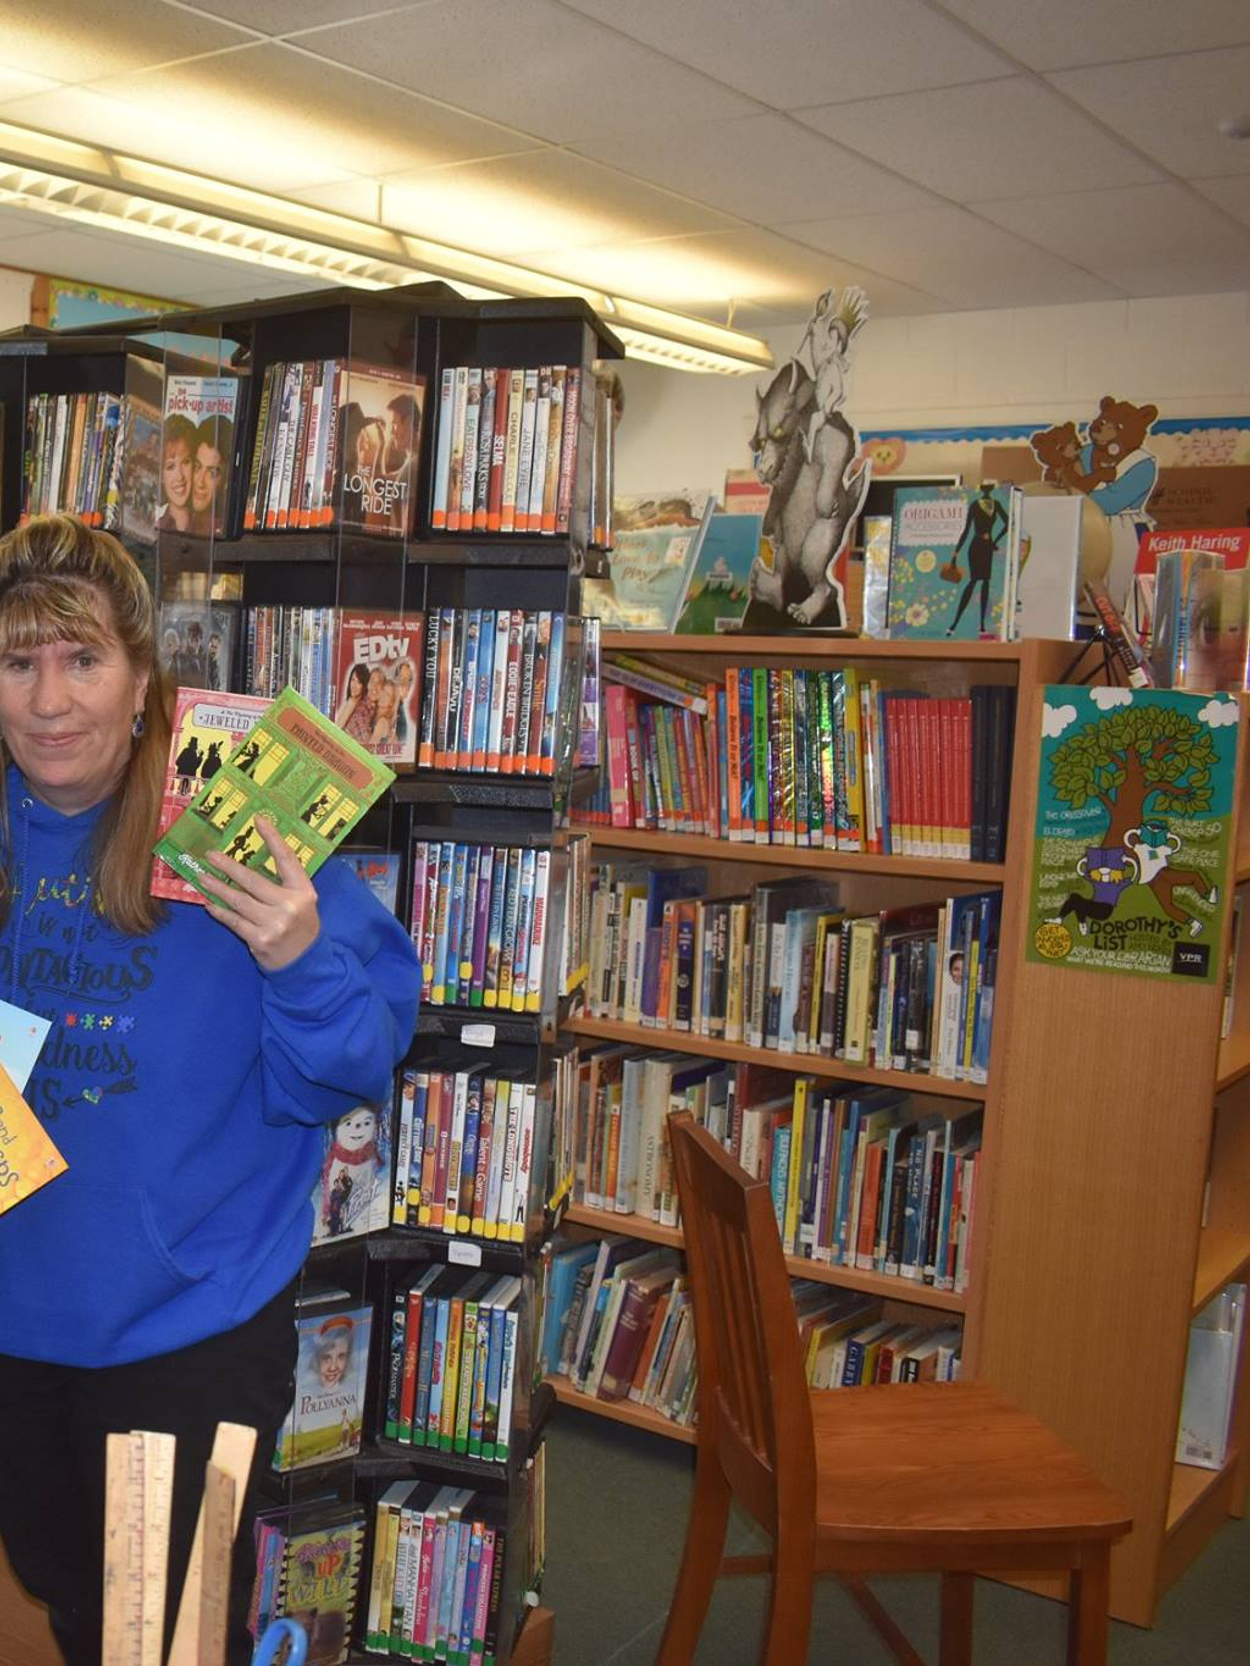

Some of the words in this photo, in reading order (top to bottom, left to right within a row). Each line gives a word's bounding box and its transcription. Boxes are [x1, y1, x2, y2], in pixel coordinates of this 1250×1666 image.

[168, 396, 203, 415] pick-up
[205, 399, 233, 413] artist
[467, 419, 475, 436] EAT
[508, 412, 518, 455] CHARLIE
[464, 438, 473, 464] PRAY
[492, 435, 504, 466] SELMA
[522, 428, 531, 457] JANE
[342, 473, 408, 500] LONGEST
[463, 465, 473, 493] LOVE
[519, 461, 529, 489] EYRE
[361, 493, 392, 516] RIDE
[904, 507, 962, 520] ORIGAMI
[1149, 537, 1187, 550] Keith
[1191, 535, 1241, 551] Haring
[428, 615, 439, 651] LUCKY
[354, 634, 410, 663] EDtv
[426, 657, 436, 679] YOU
[508, 661, 517, 686] EDDIE
[521, 654, 534, 694] BROKEN
[506, 692, 516, 718] EAGLE
[533, 679, 544, 711] Smile
[204, 713, 249, 730] JEWELED
[518, 696, 530, 738] BRIDGES
[1089, 917, 1182, 939] DOROTHY'S
[1179, 953, 1202, 963] VPR
[478, 1136, 490, 1164] Talent
[504, 1127, 516, 1182] LONGSHOTS
[521, 1129, 530, 1174] somebody
[644, 1134, 655, 1196] ASTRONOMY
[475, 1173, 485, 1201] Game
[913, 1168, 921, 1199] PLACE
[301, 1394, 357, 1415] POLLYANNA
[493, 1555, 502, 1580] POLAR
[404, 1559, 417, 1627] MANHATTAN
